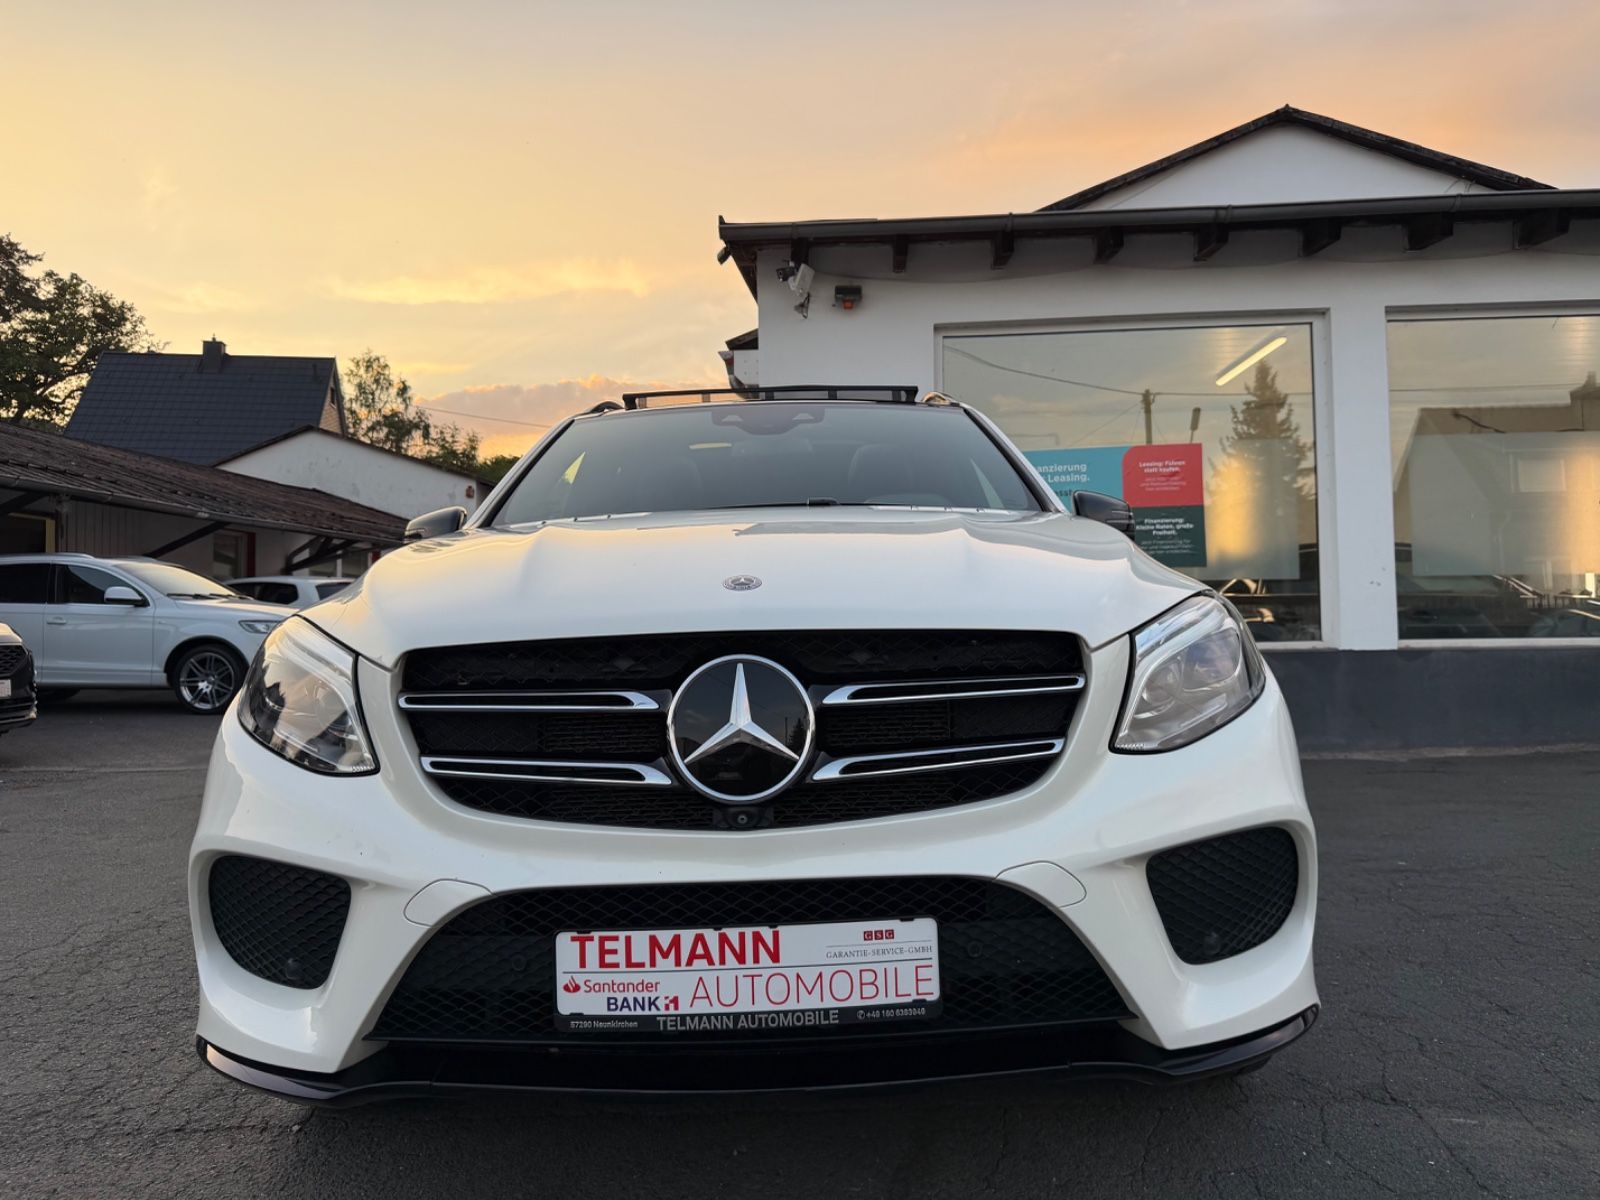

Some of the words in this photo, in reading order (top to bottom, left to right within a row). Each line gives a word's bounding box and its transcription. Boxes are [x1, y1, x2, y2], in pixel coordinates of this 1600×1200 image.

[1037, 464, 1088, 473] anzierung
[1047, 473, 1091, 483] Leasing.
[863, 929, 895, 942] GSG
[570, 930, 781, 969] TELMANN
[583, 978, 660, 994] Santander
[689, 964, 934, 1008] AUTOMOBILE
[593, 1019, 639, 1029] Neunkirchen
[656, 1014, 734, 1032] TELMANN
[738, 1009, 839, 1029] AUTOMOBILE
